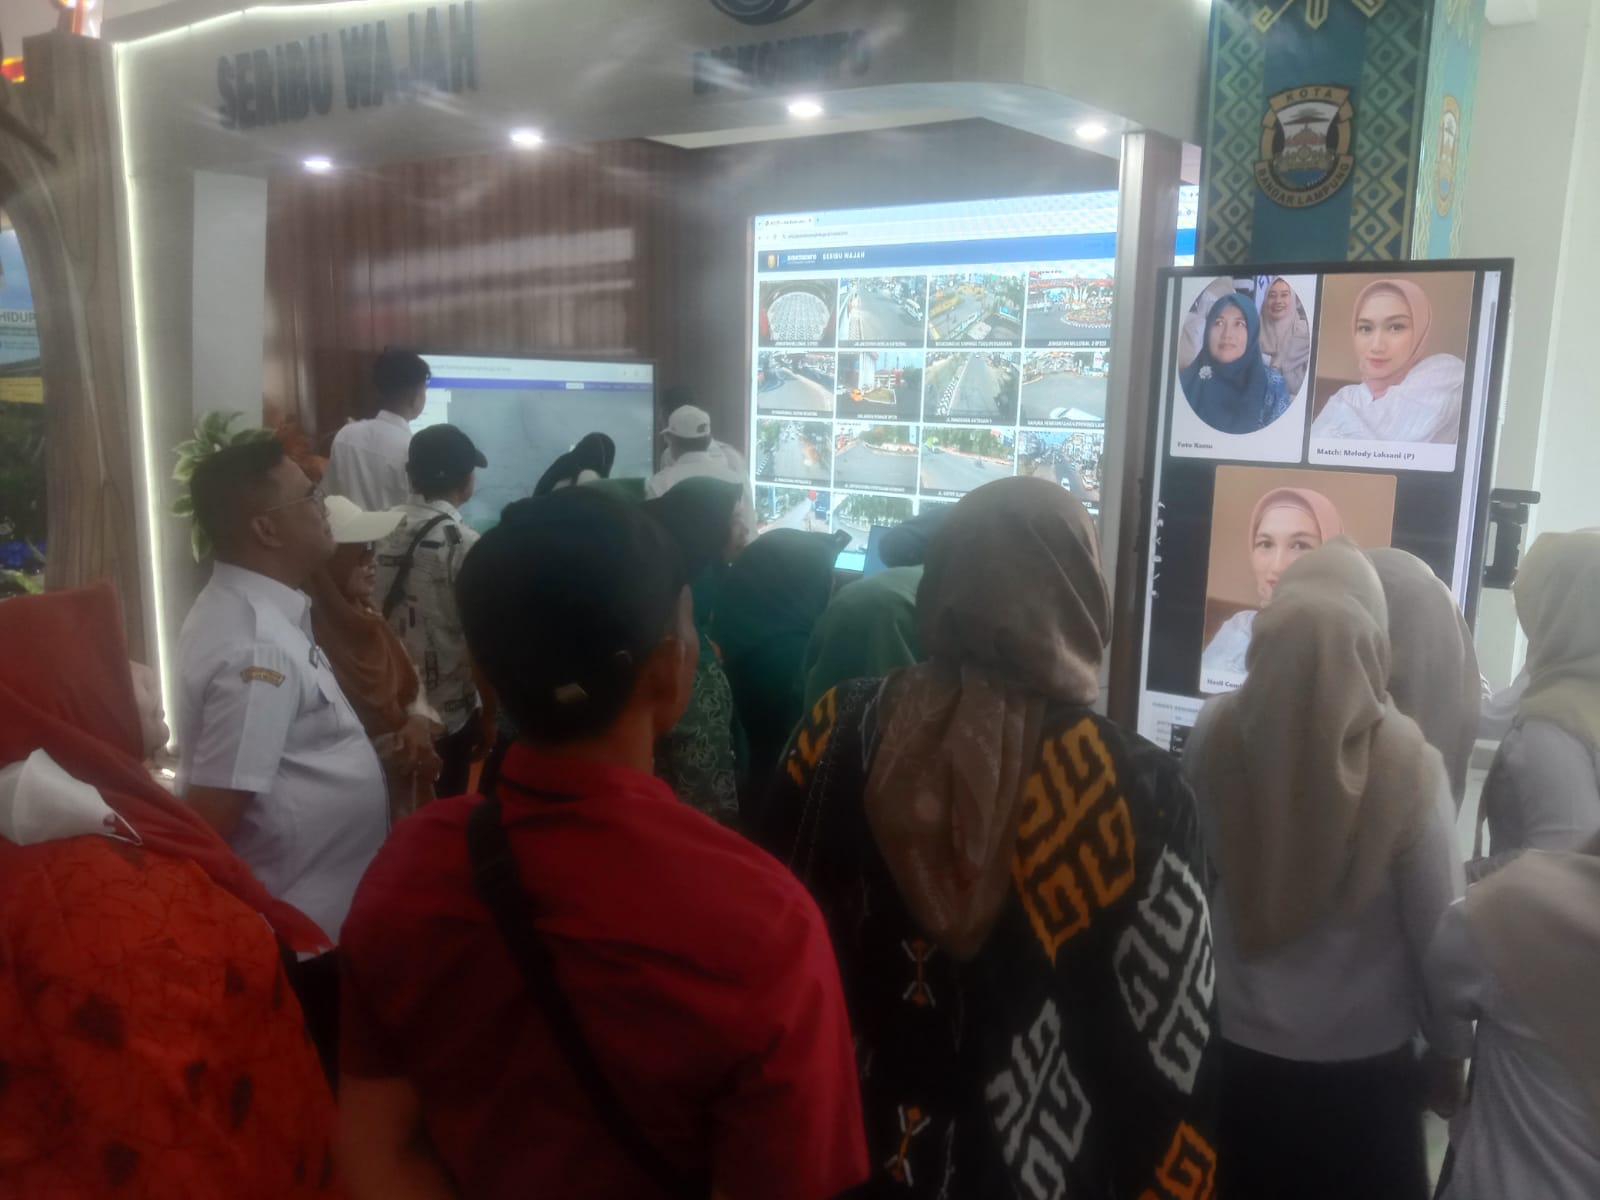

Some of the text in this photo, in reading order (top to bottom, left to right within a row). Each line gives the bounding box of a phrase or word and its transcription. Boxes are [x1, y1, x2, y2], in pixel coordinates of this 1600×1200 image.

[218, 1, 477, 129] SERIBU WAJAH
[1286, 87, 1333, 101] KOTA
[1258, 163, 1350, 205] BANDAR LAMPUNG
[1316, 448, 1415, 461] Match: Melody Laksani (P)
